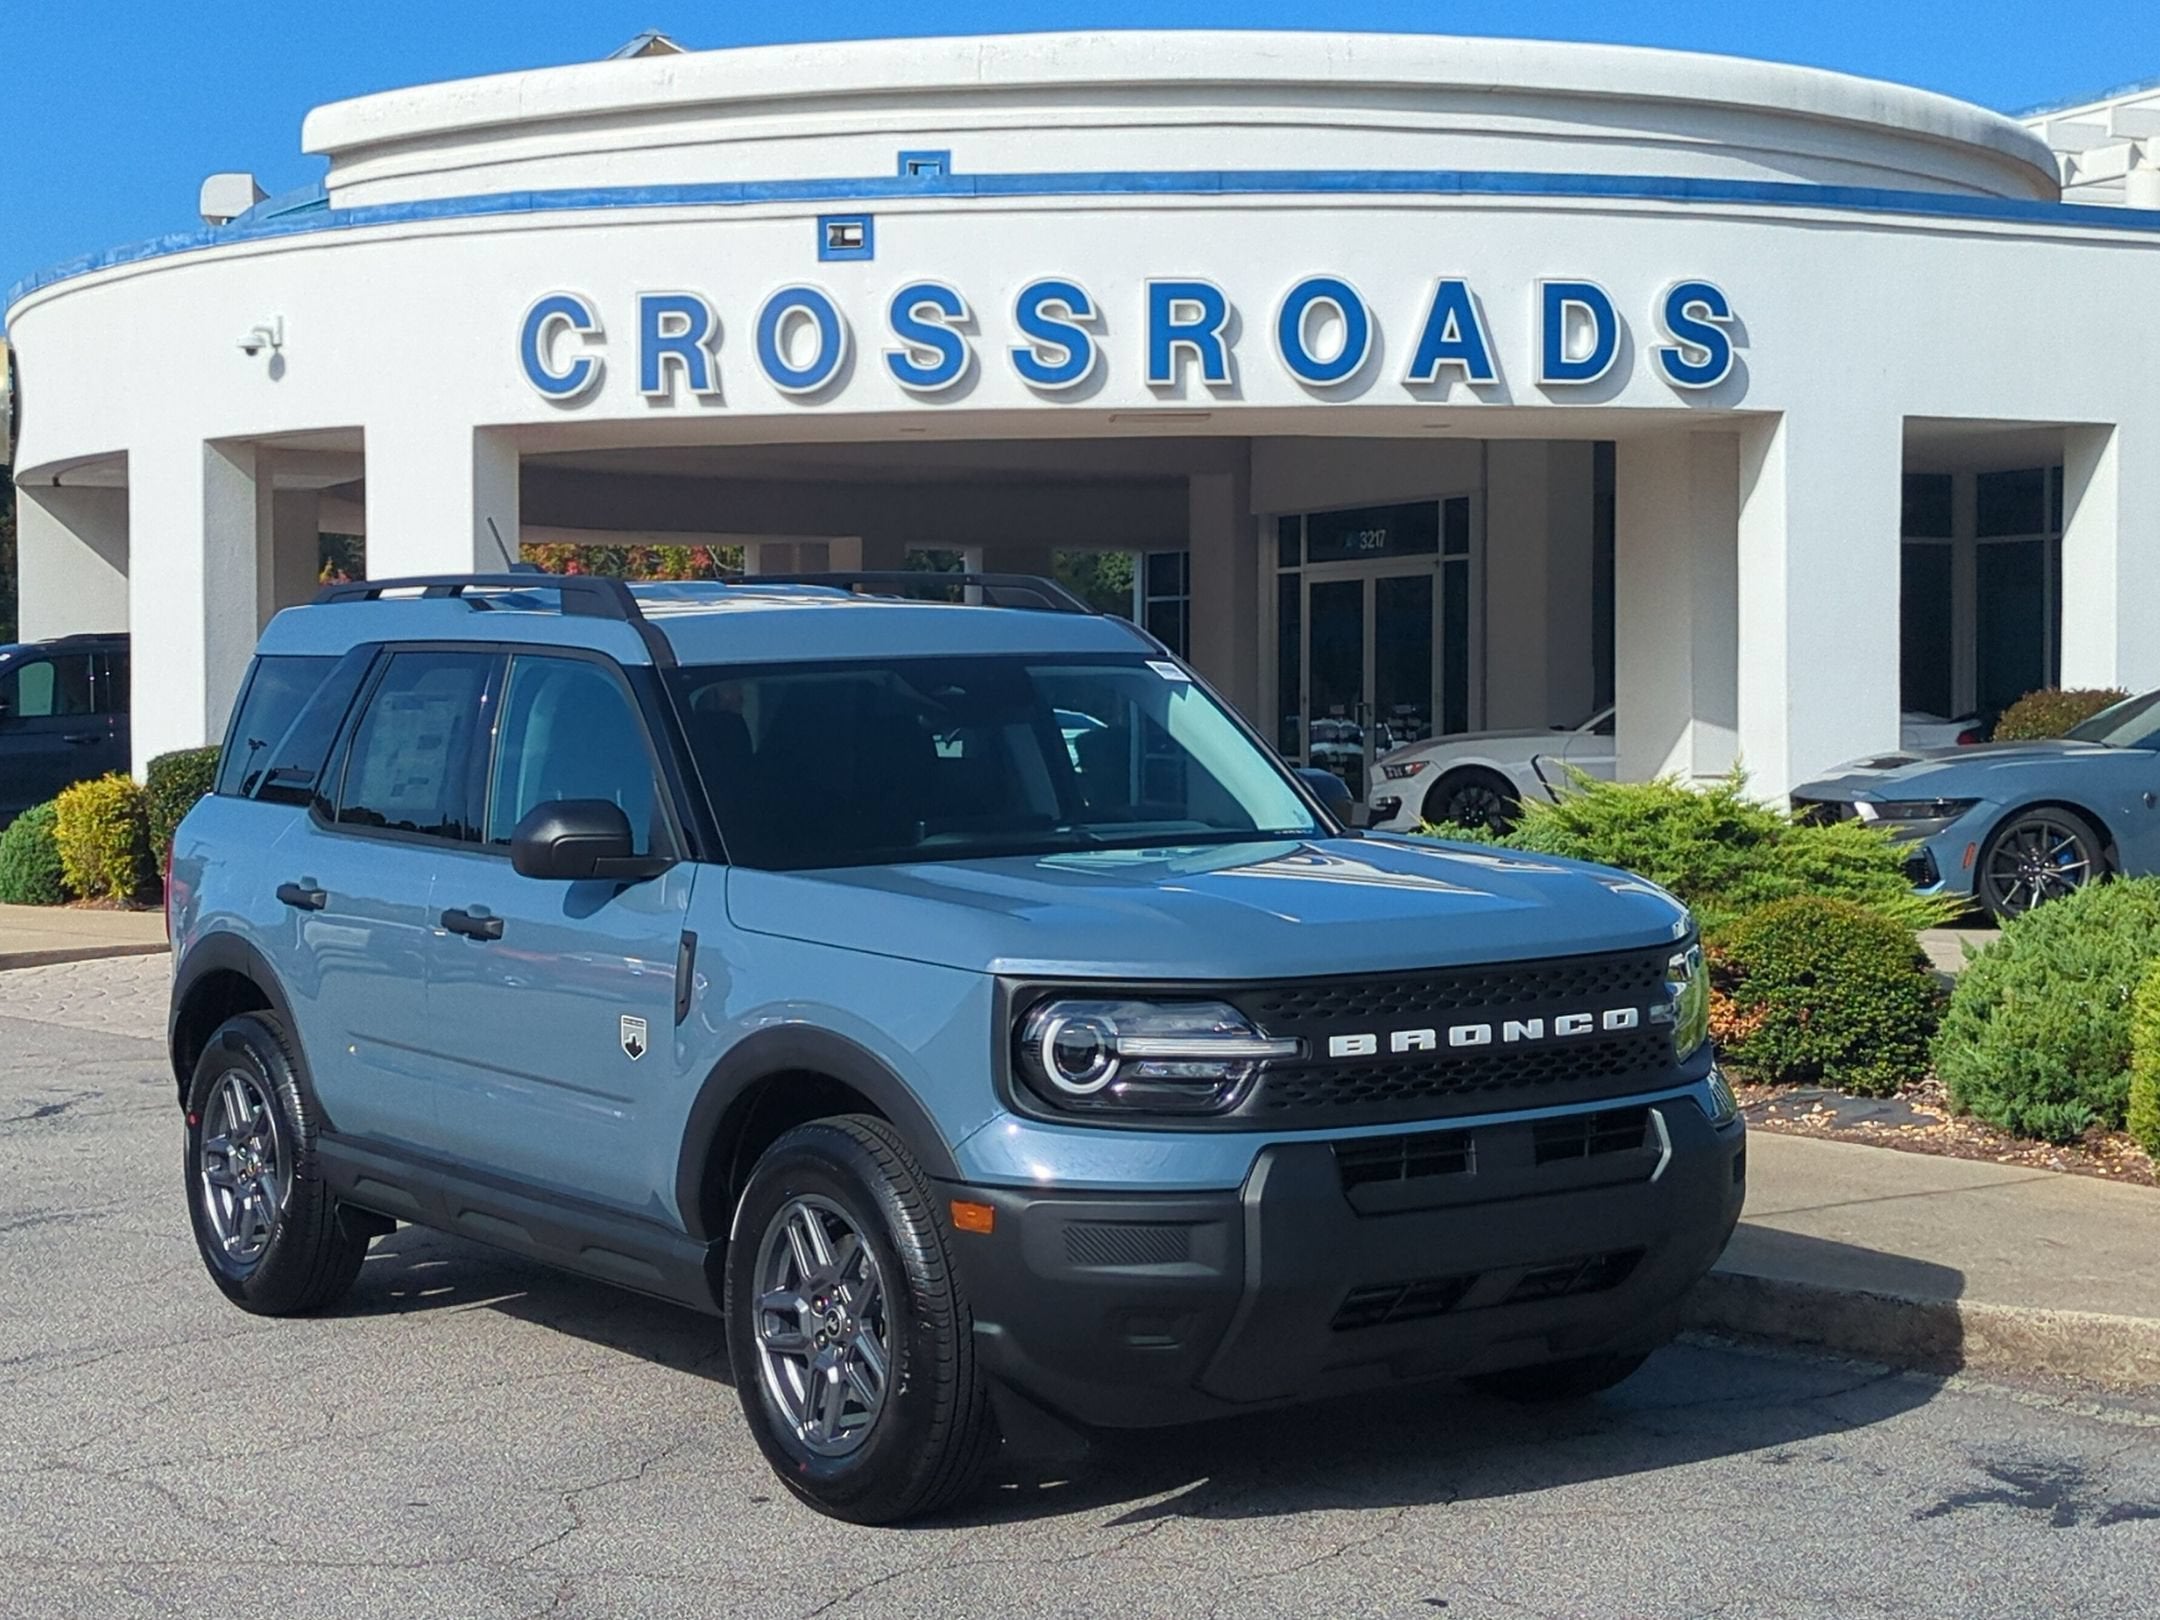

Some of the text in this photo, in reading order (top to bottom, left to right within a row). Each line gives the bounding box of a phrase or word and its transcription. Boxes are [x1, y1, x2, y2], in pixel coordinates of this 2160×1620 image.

[518, 275, 1739, 401] CROSSROADS
[1359, 529, 1386, 549] 3217
[1328, 1007, 1639, 1058] BRONCO
